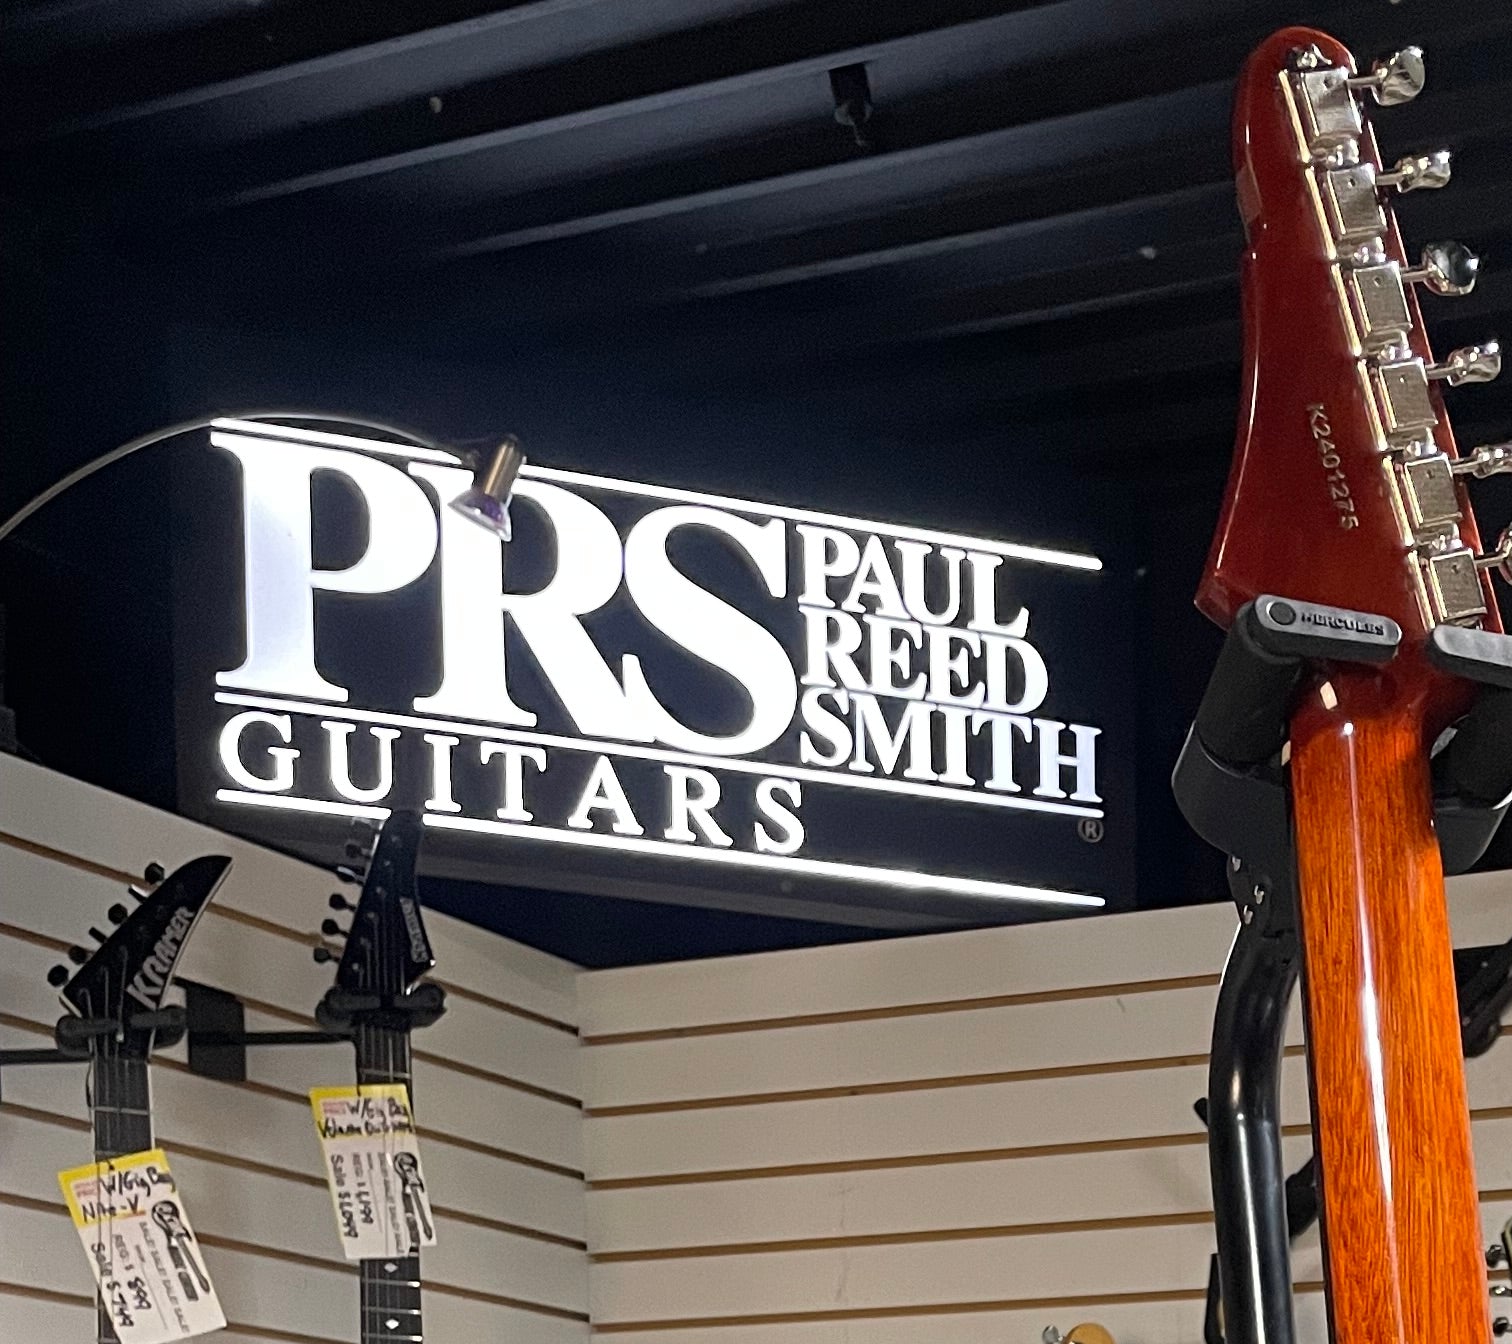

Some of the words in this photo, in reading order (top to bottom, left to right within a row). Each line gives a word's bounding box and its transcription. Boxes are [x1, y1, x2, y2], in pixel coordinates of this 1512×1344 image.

[211, 431, 798, 756] PRS
[797, 523, 1030, 638] PAUL
[1300, 612, 1385, 636] HERCULES
[801, 606, 1049, 715] REED
[218, 711, 804, 856] GUITARS
[801, 686, 1104, 804] SMITH
[126, 905, 195, 1012] KRAMER
